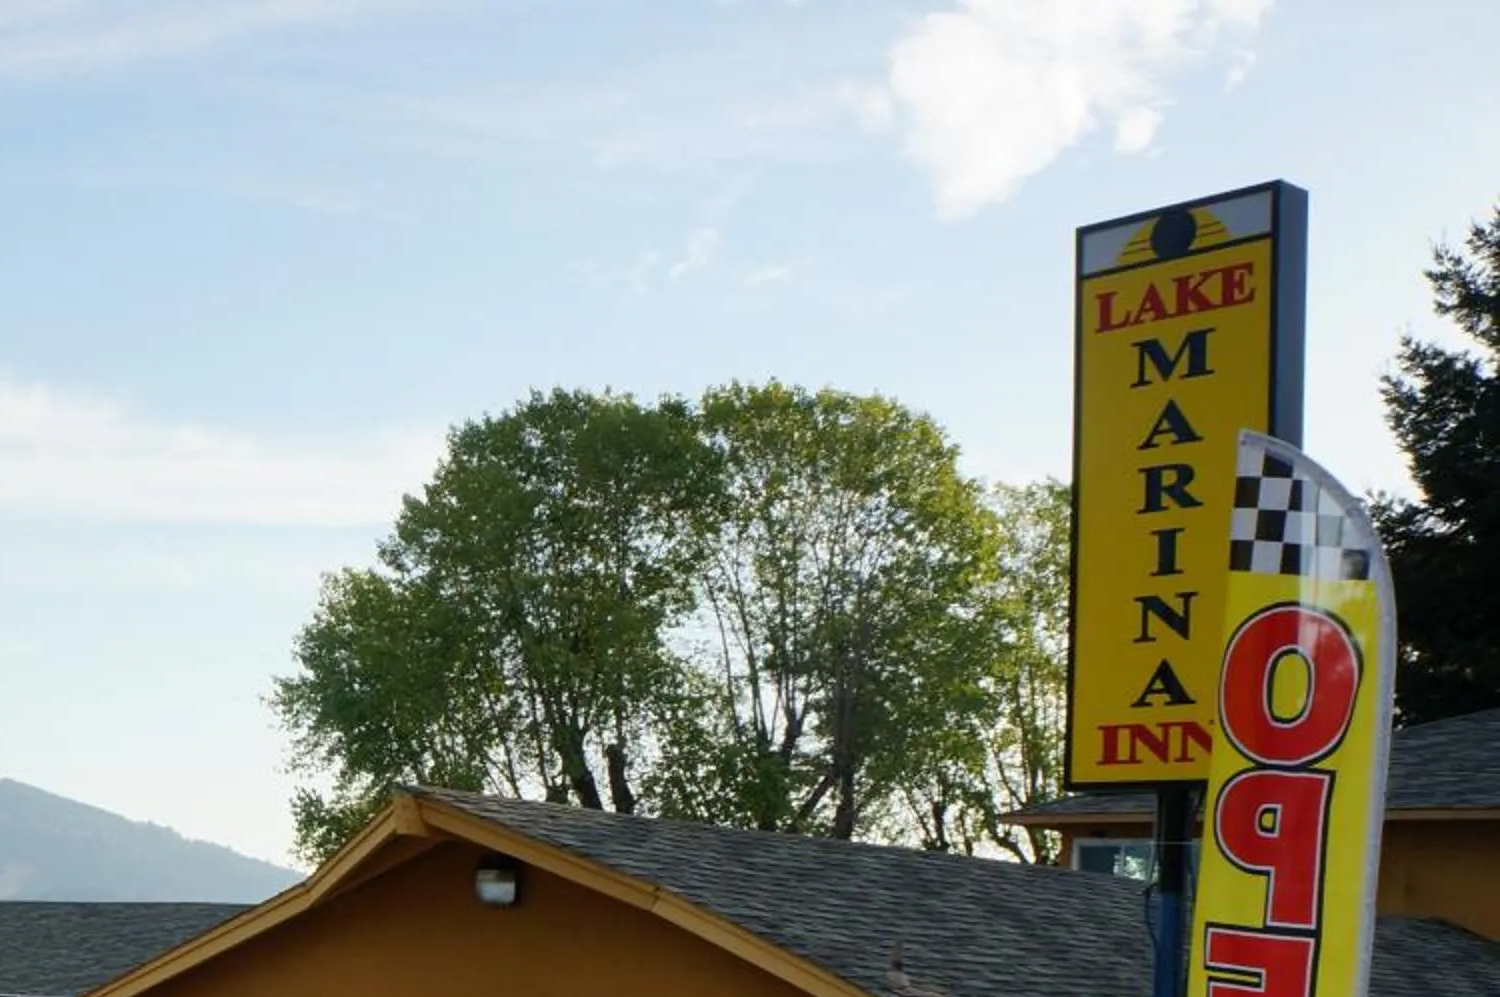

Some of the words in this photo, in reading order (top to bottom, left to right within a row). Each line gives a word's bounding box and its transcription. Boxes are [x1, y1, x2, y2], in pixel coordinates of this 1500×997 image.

[1095, 263, 1256, 333] LAKE
[1130, 327, 1216, 709] MARINA
[1096, 720, 1214, 766] INN
